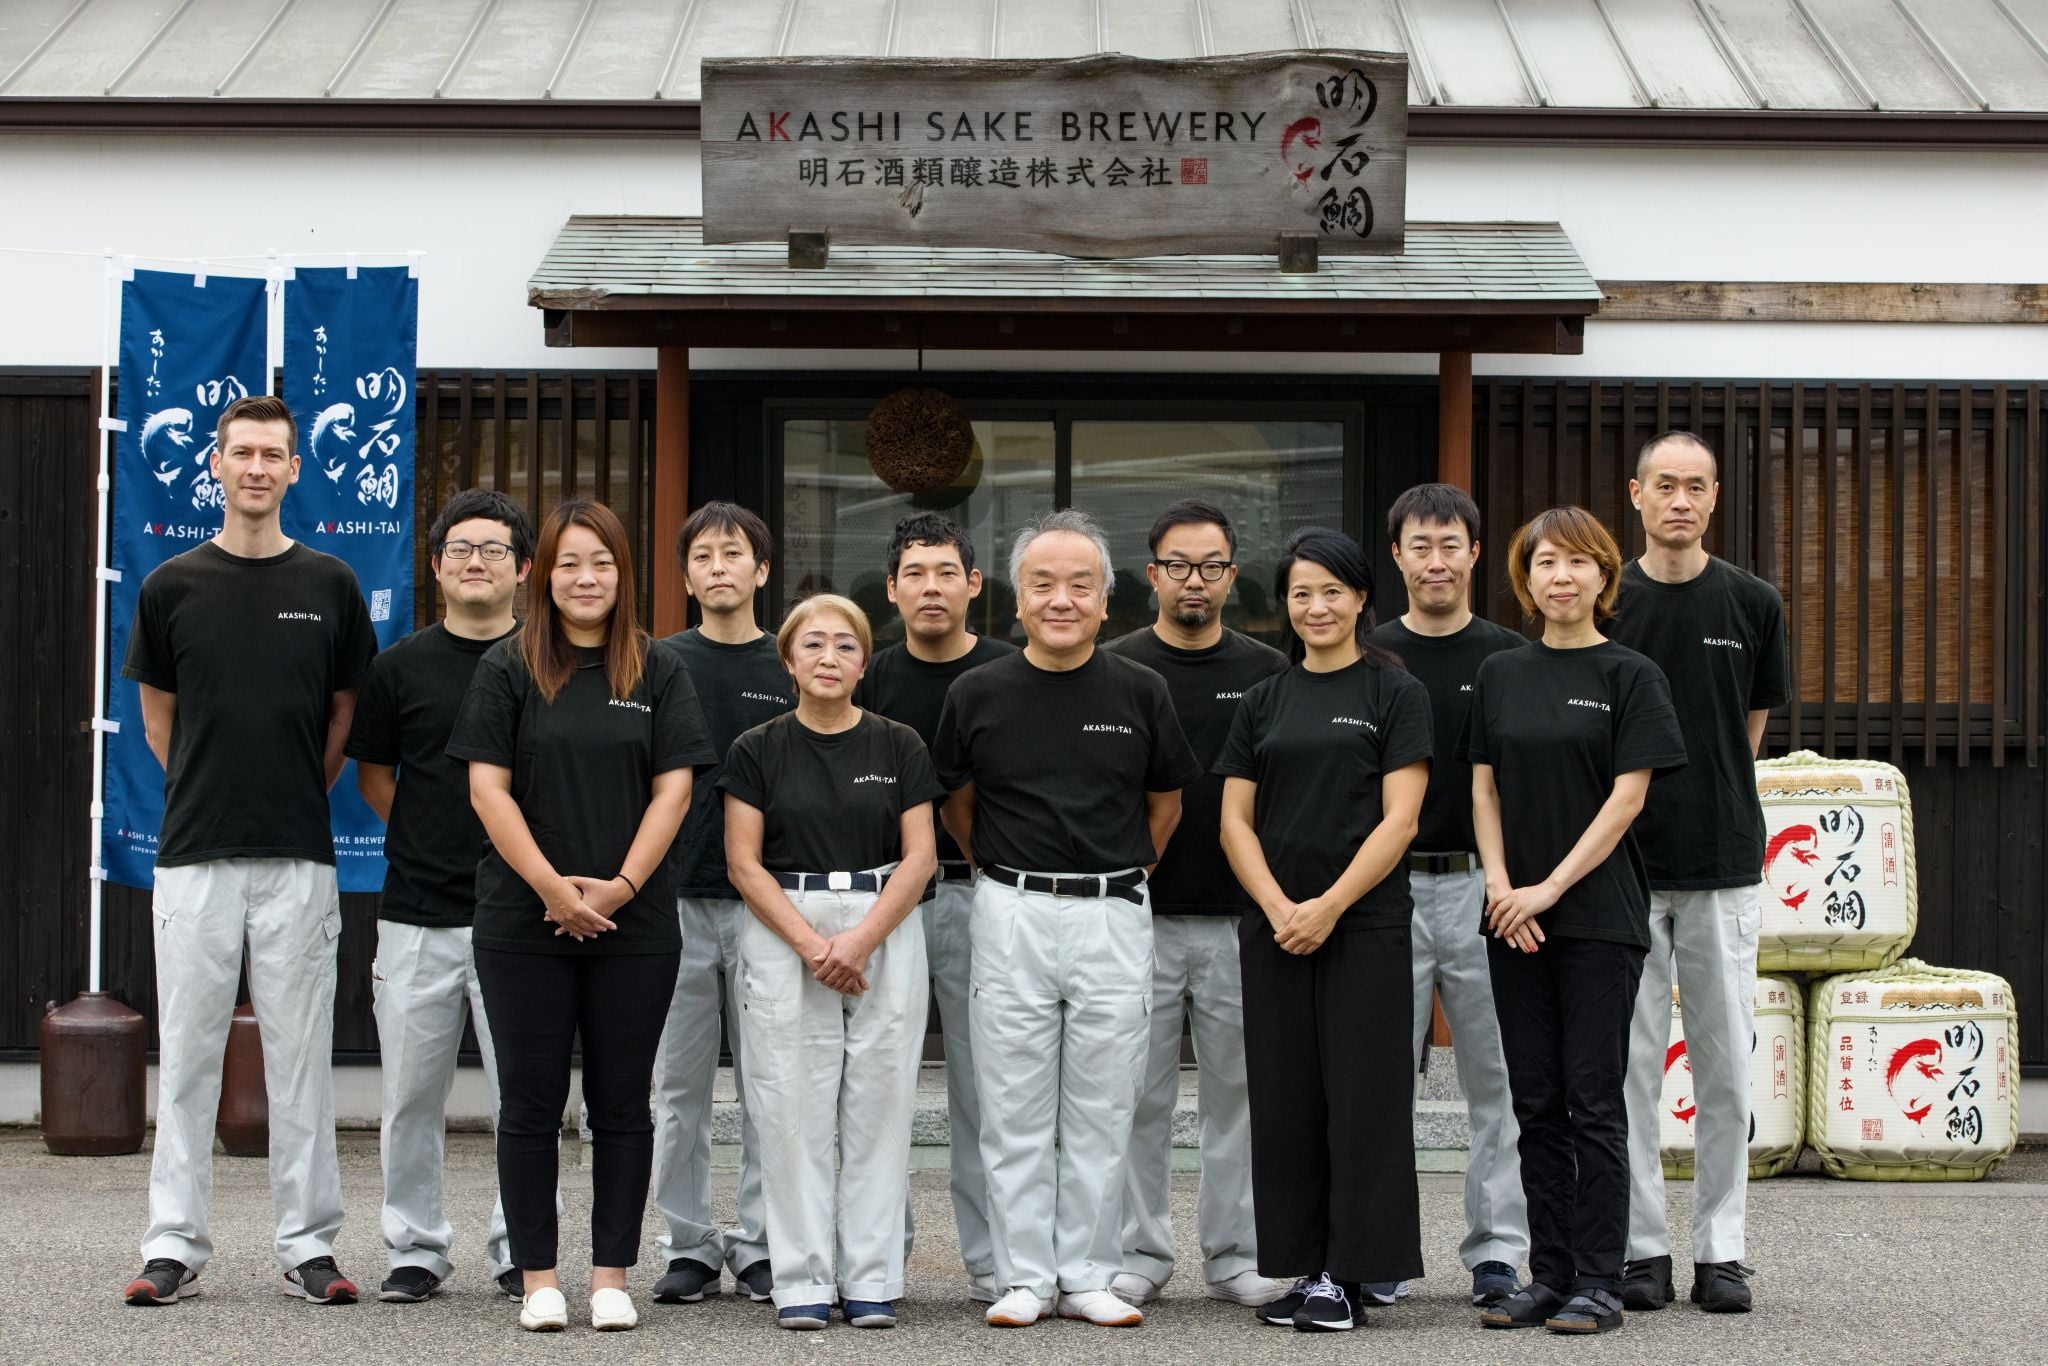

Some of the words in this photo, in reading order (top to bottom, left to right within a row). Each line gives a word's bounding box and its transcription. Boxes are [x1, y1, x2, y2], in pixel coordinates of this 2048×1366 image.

[736, 111, 900, 142] AKASHI
[926, 111, 1033, 142] SAKE
[1061, 111, 1267, 142] BREWERY
[798, 156, 1173, 188] 明石酒類醸造株式会社
[143, 521, 222, 540] AKASHI-T
[315, 520, 400, 535] AKASHI-TAI
[277, 611, 321, 622] AKASHI-TAI
[1703, 636, 1742, 650] AKASHI-TAI
[741, 690, 788, 705] AKASHI-TAI
[1567, 698, 1611, 712] AKASHI-TA
[1082, 723, 1132, 735] AKASHI-TAI
[1331, 716, 1378, 733] AKASHI-TAI
[852, 773, 897, 785] AKASHI-TAI
[147, 834, 159, 844] SA
[332, 836, 350, 845] AKE
[1840, 991, 1869, 1005] 登録
[1839, 1036, 1855, 1111] 品質本位
